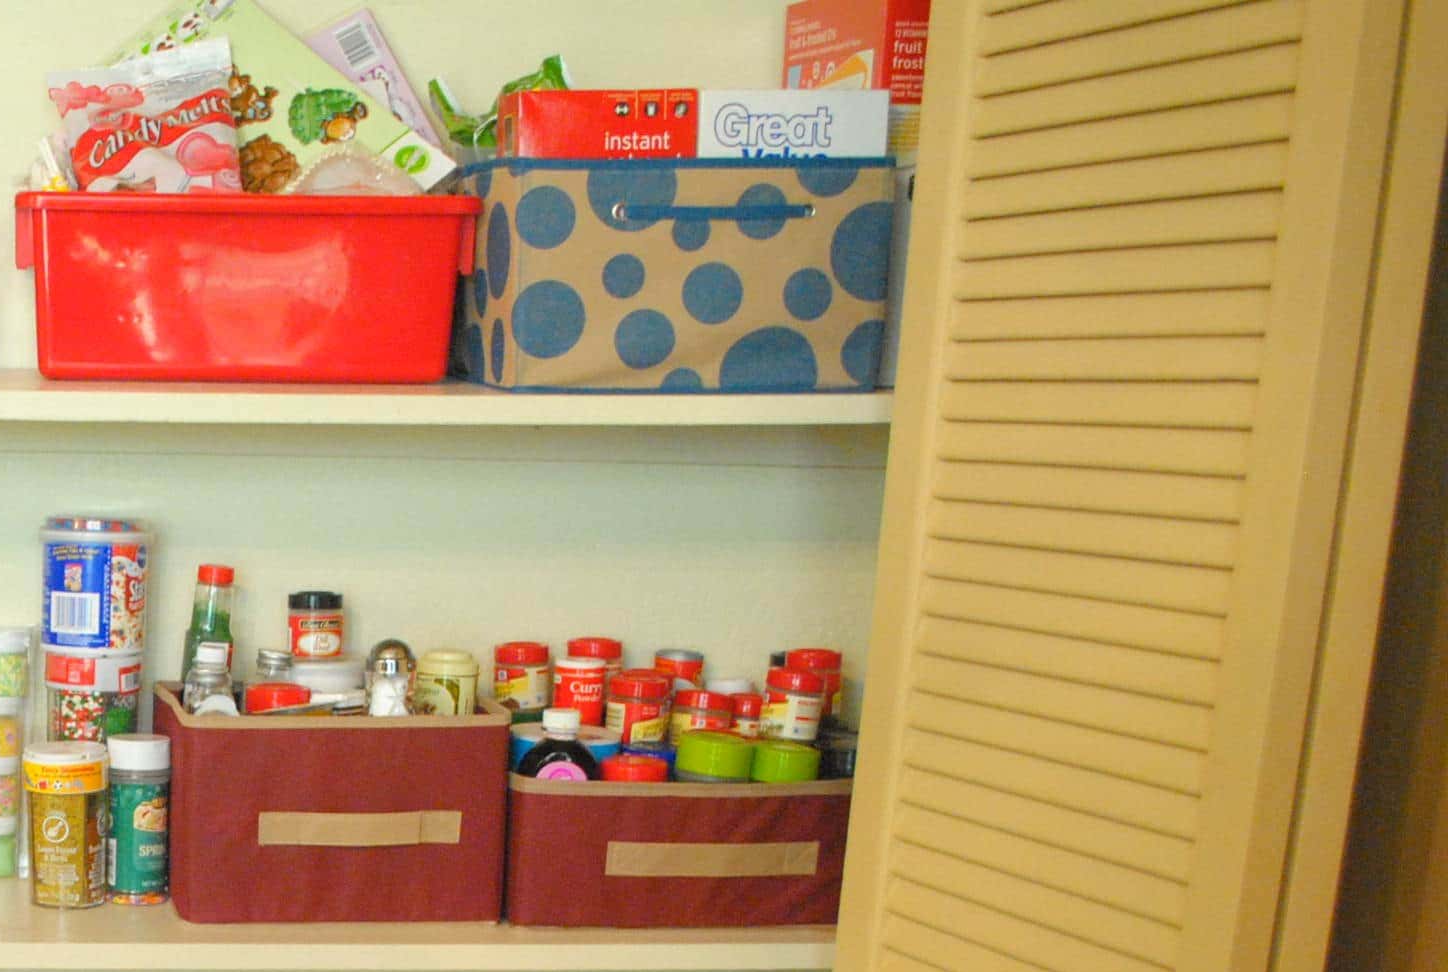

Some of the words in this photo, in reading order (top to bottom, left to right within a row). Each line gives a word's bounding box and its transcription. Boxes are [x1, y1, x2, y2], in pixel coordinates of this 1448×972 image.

[893, 40, 923, 54] fruit
[892, 56, 924, 70] frost
[89, 118, 162, 168] Candy
[166, 96, 232, 128] Melts
[714, 102, 833, 149] Great
[604, 131, 671, 151] instant
[570, 681, 602, 695] Curr
